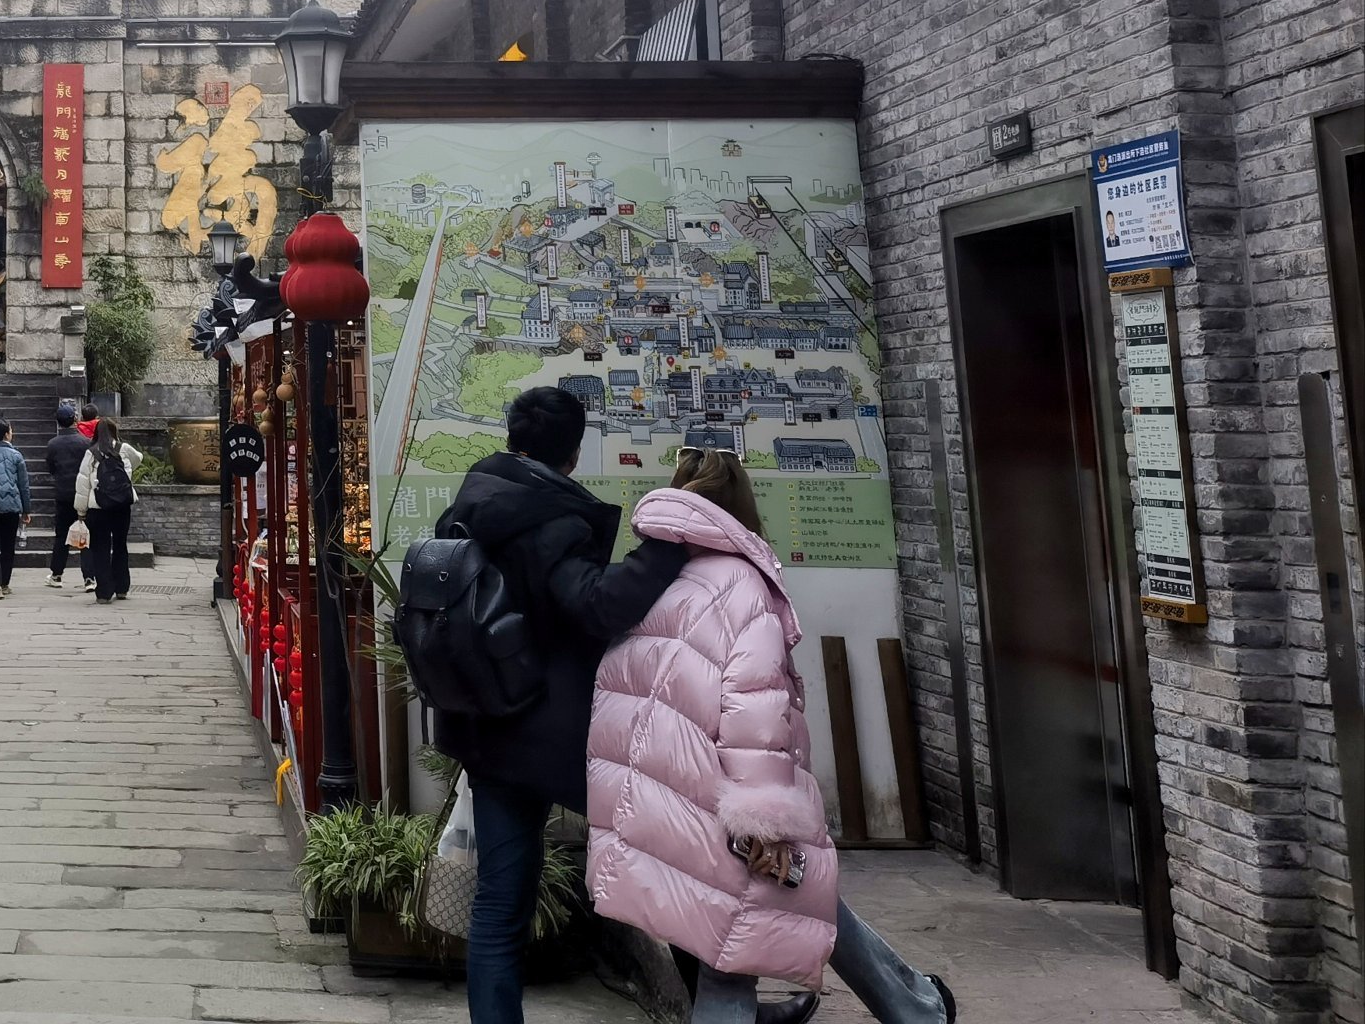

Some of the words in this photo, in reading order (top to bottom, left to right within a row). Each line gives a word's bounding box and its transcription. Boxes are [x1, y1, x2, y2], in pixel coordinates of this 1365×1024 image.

[1107, 175, 1167, 201] 您身边的社区民警
